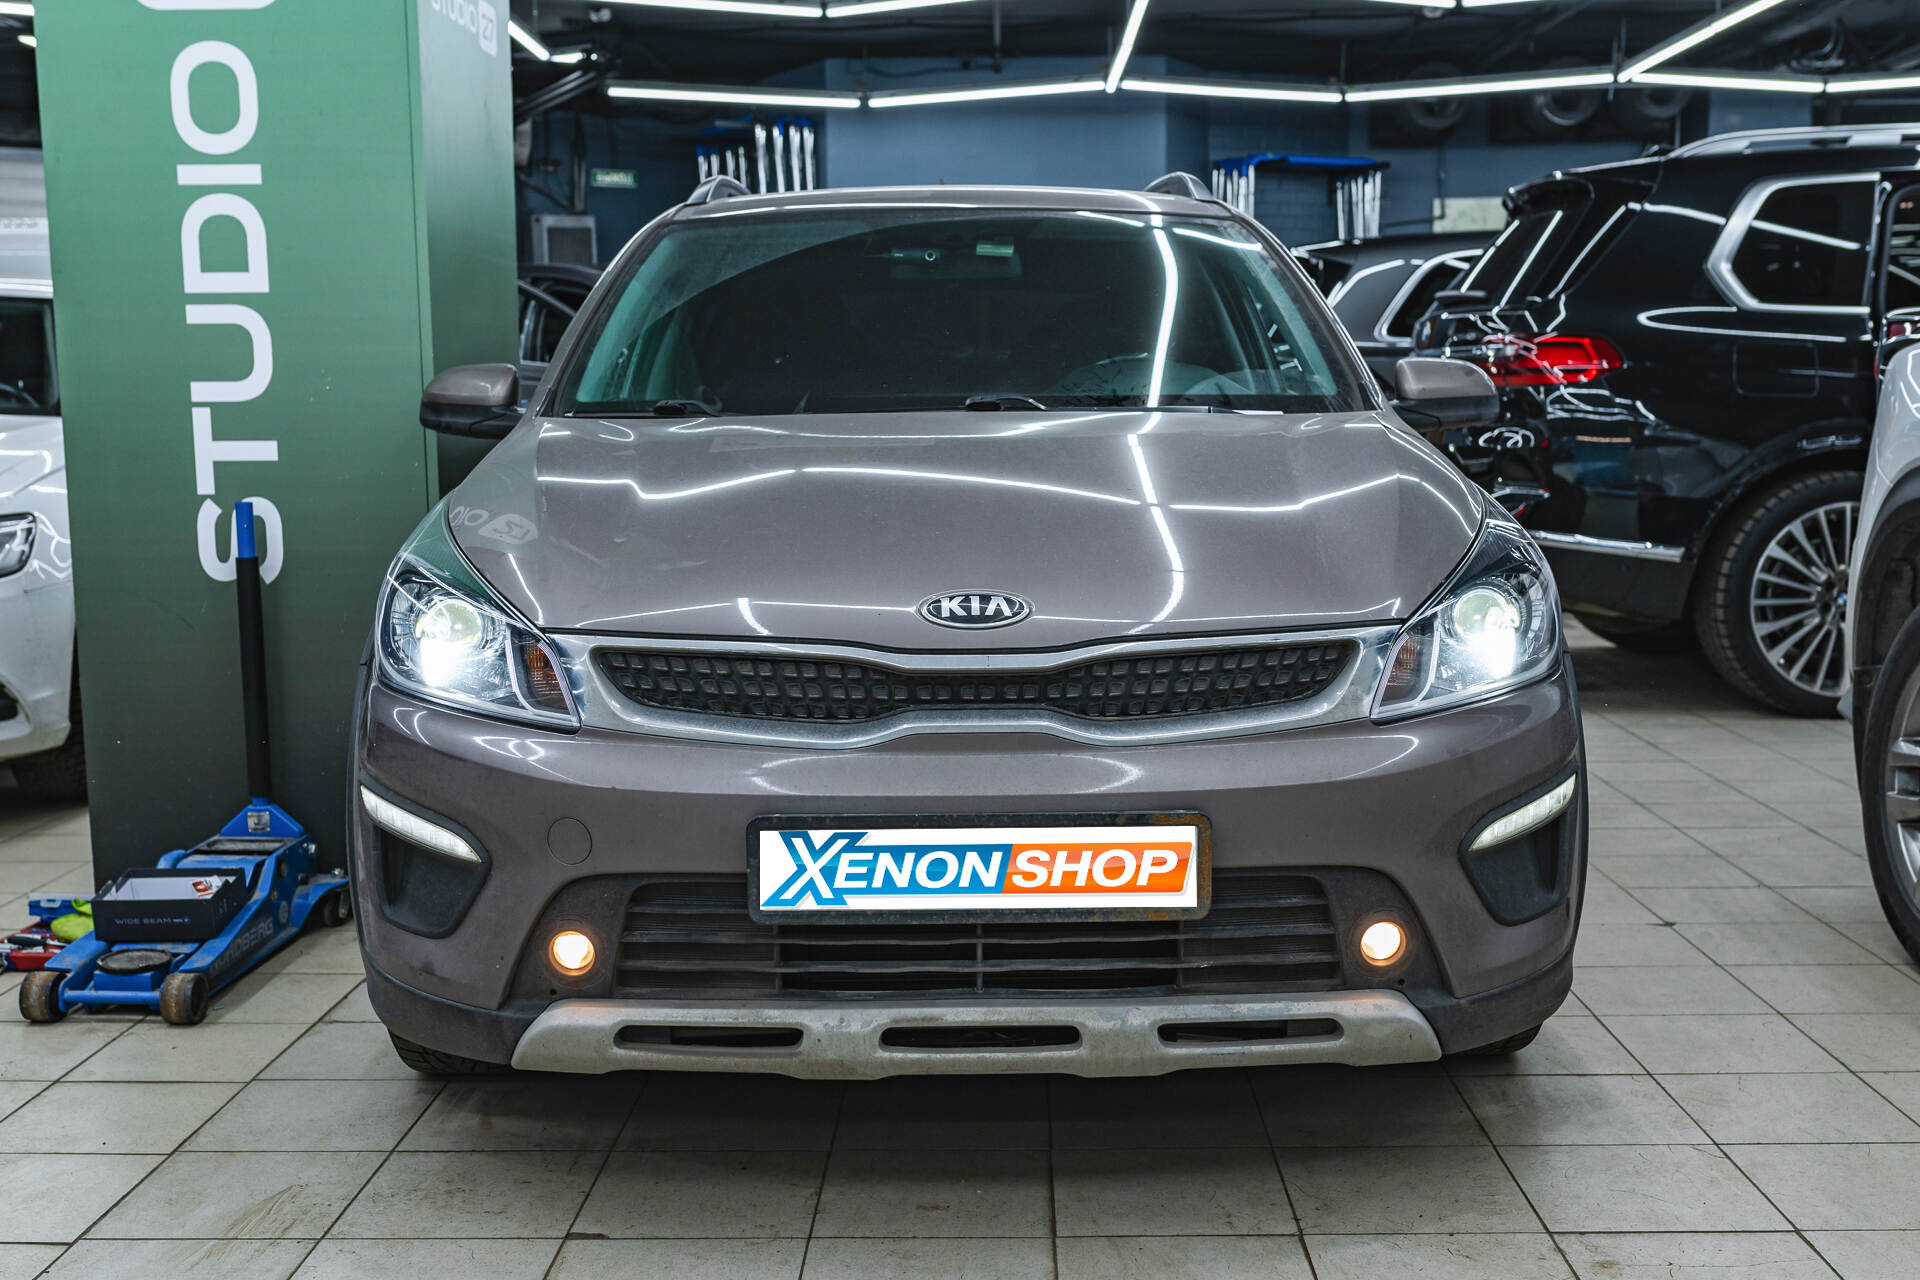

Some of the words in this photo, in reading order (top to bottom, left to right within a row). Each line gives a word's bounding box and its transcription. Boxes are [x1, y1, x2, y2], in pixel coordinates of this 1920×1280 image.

[170, 40, 284, 585] STUDIO
[940, 596, 1012, 617] KIA
[143, 917, 172, 925] BEAM
